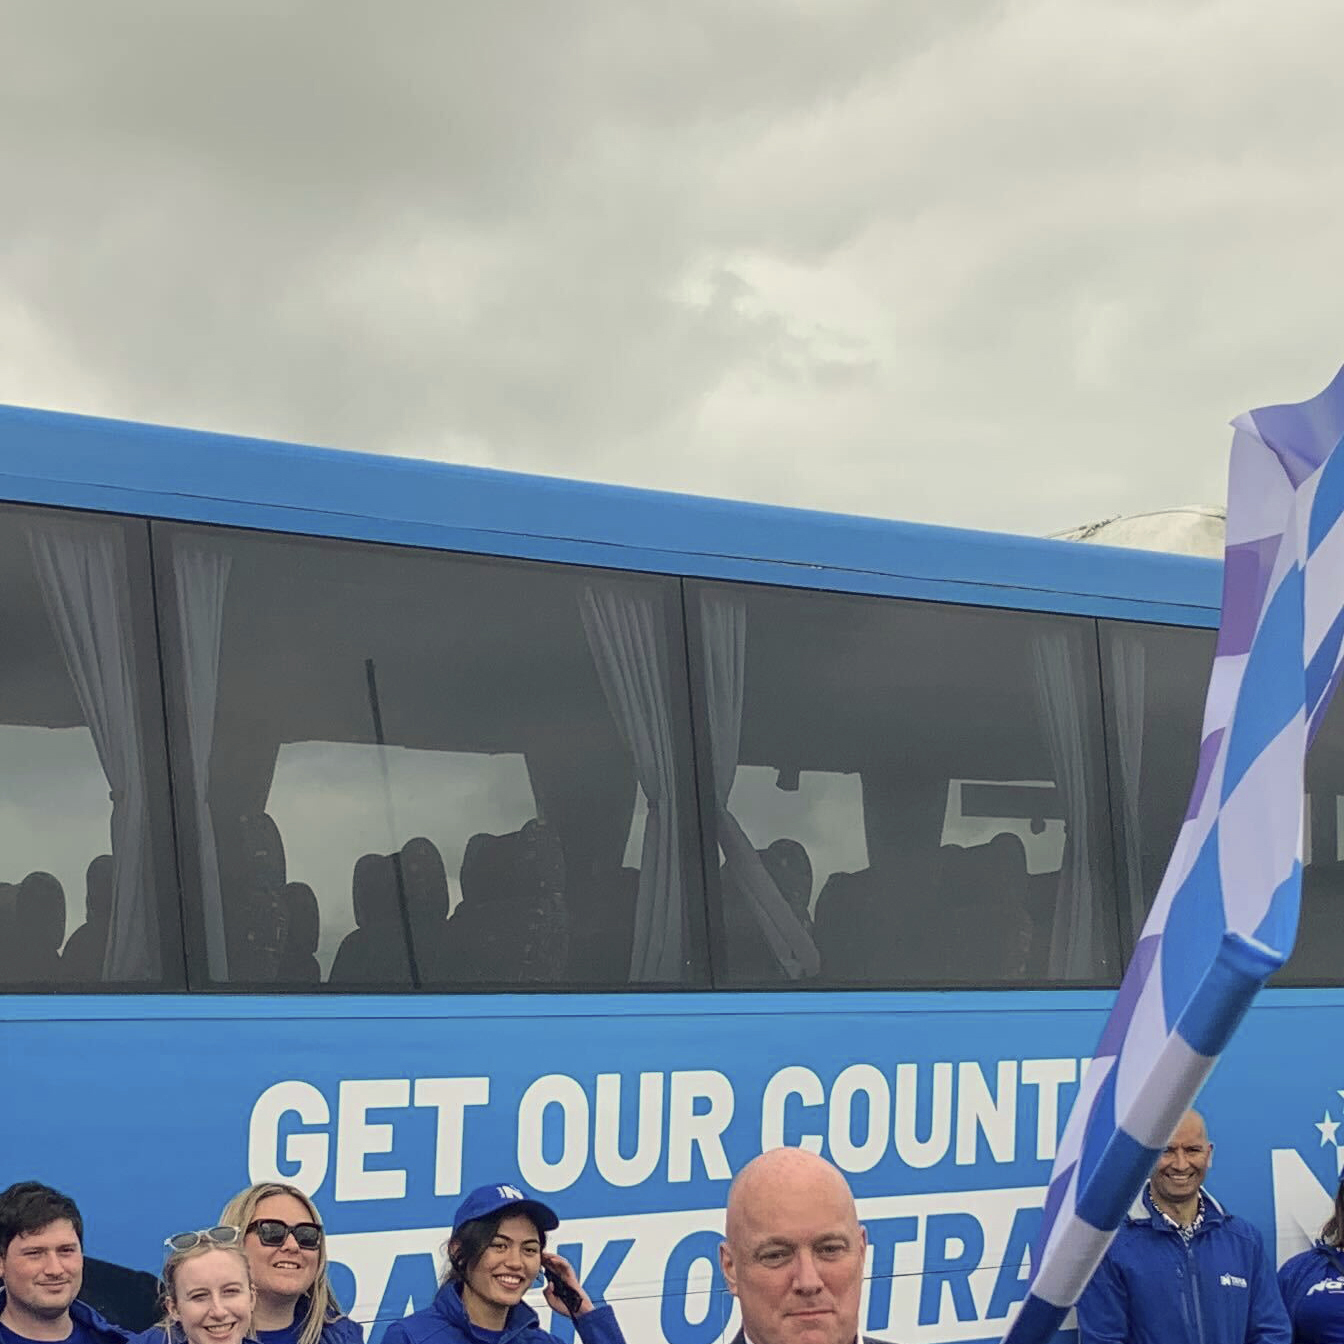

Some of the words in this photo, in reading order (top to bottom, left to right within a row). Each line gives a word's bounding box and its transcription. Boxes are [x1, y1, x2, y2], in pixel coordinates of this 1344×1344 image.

[248, 1076, 489, 1203] GET
[517, 1069, 734, 1193] OUR
[761, 1057, 1093, 1174] COUNT
[863, 1207, 1045, 1331] TRA
